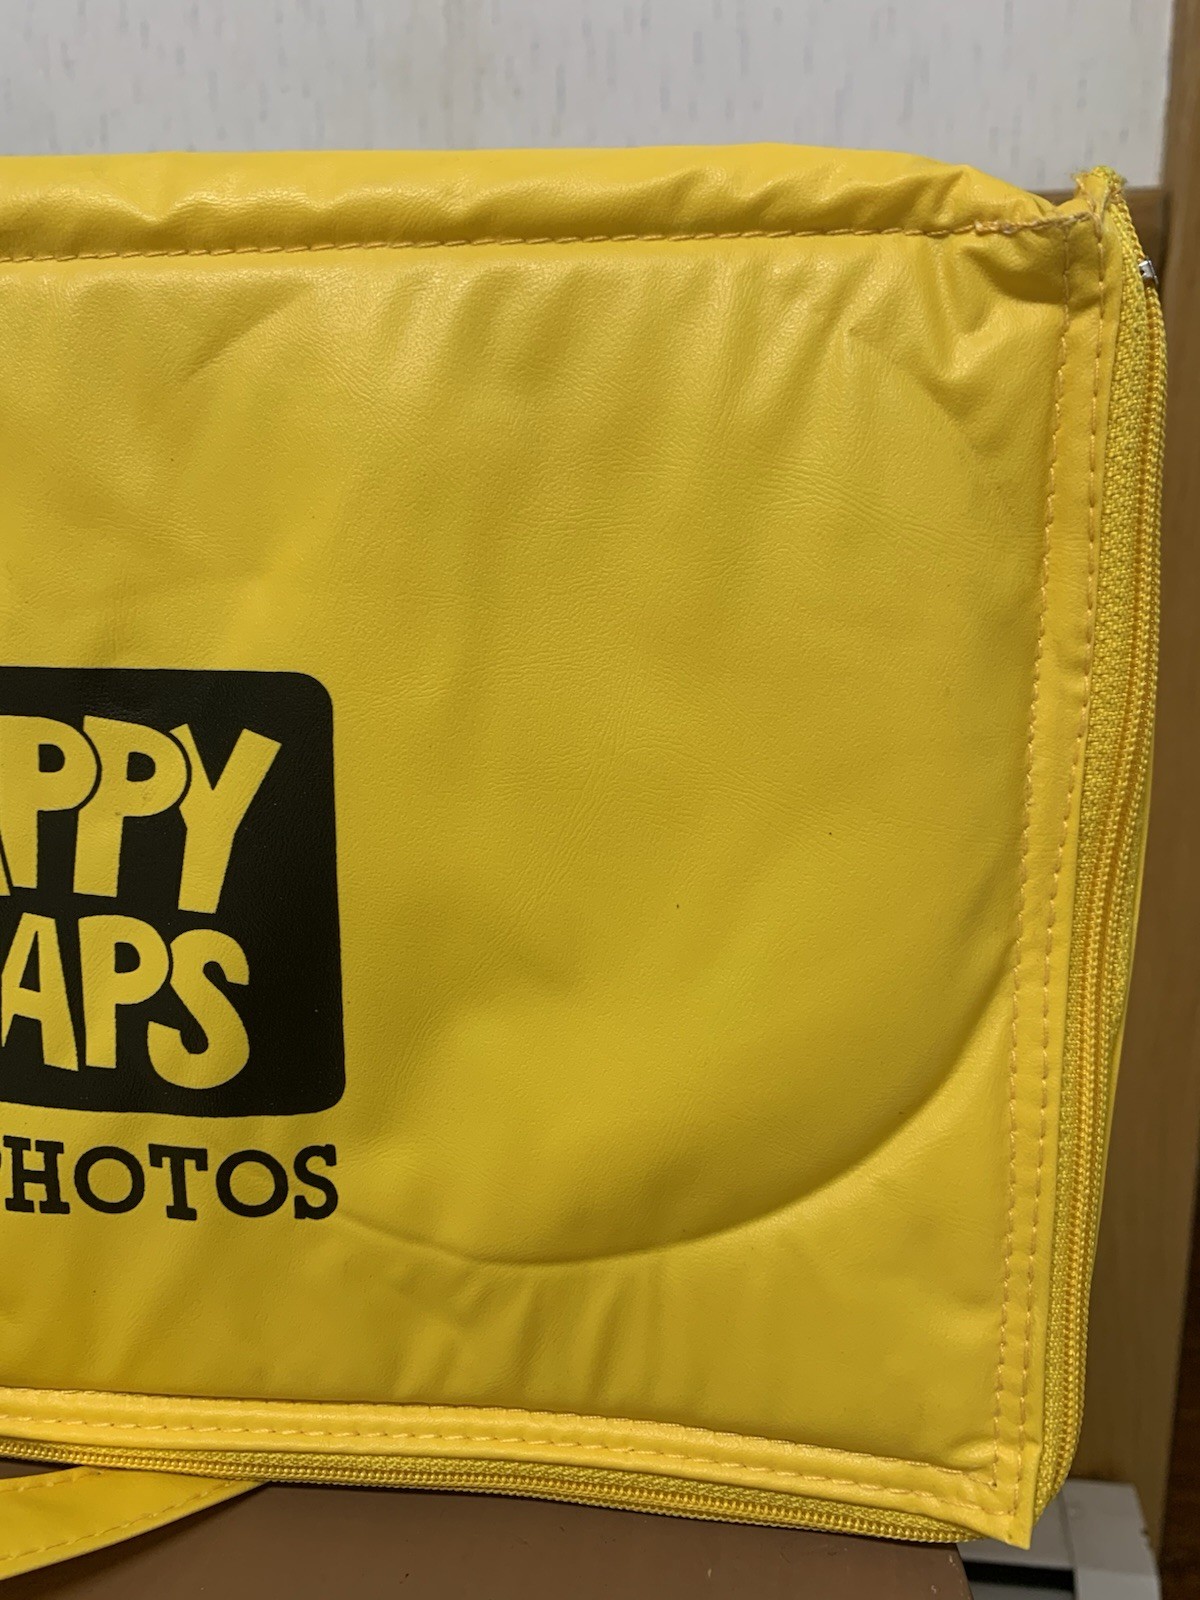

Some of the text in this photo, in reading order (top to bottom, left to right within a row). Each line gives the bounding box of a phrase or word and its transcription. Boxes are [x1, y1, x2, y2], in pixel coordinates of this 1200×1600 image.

[0, 714, 282, 914] PPY
[0, 912, 250, 1089] APS
[0, 1135, 338, 1220] HOTOS
